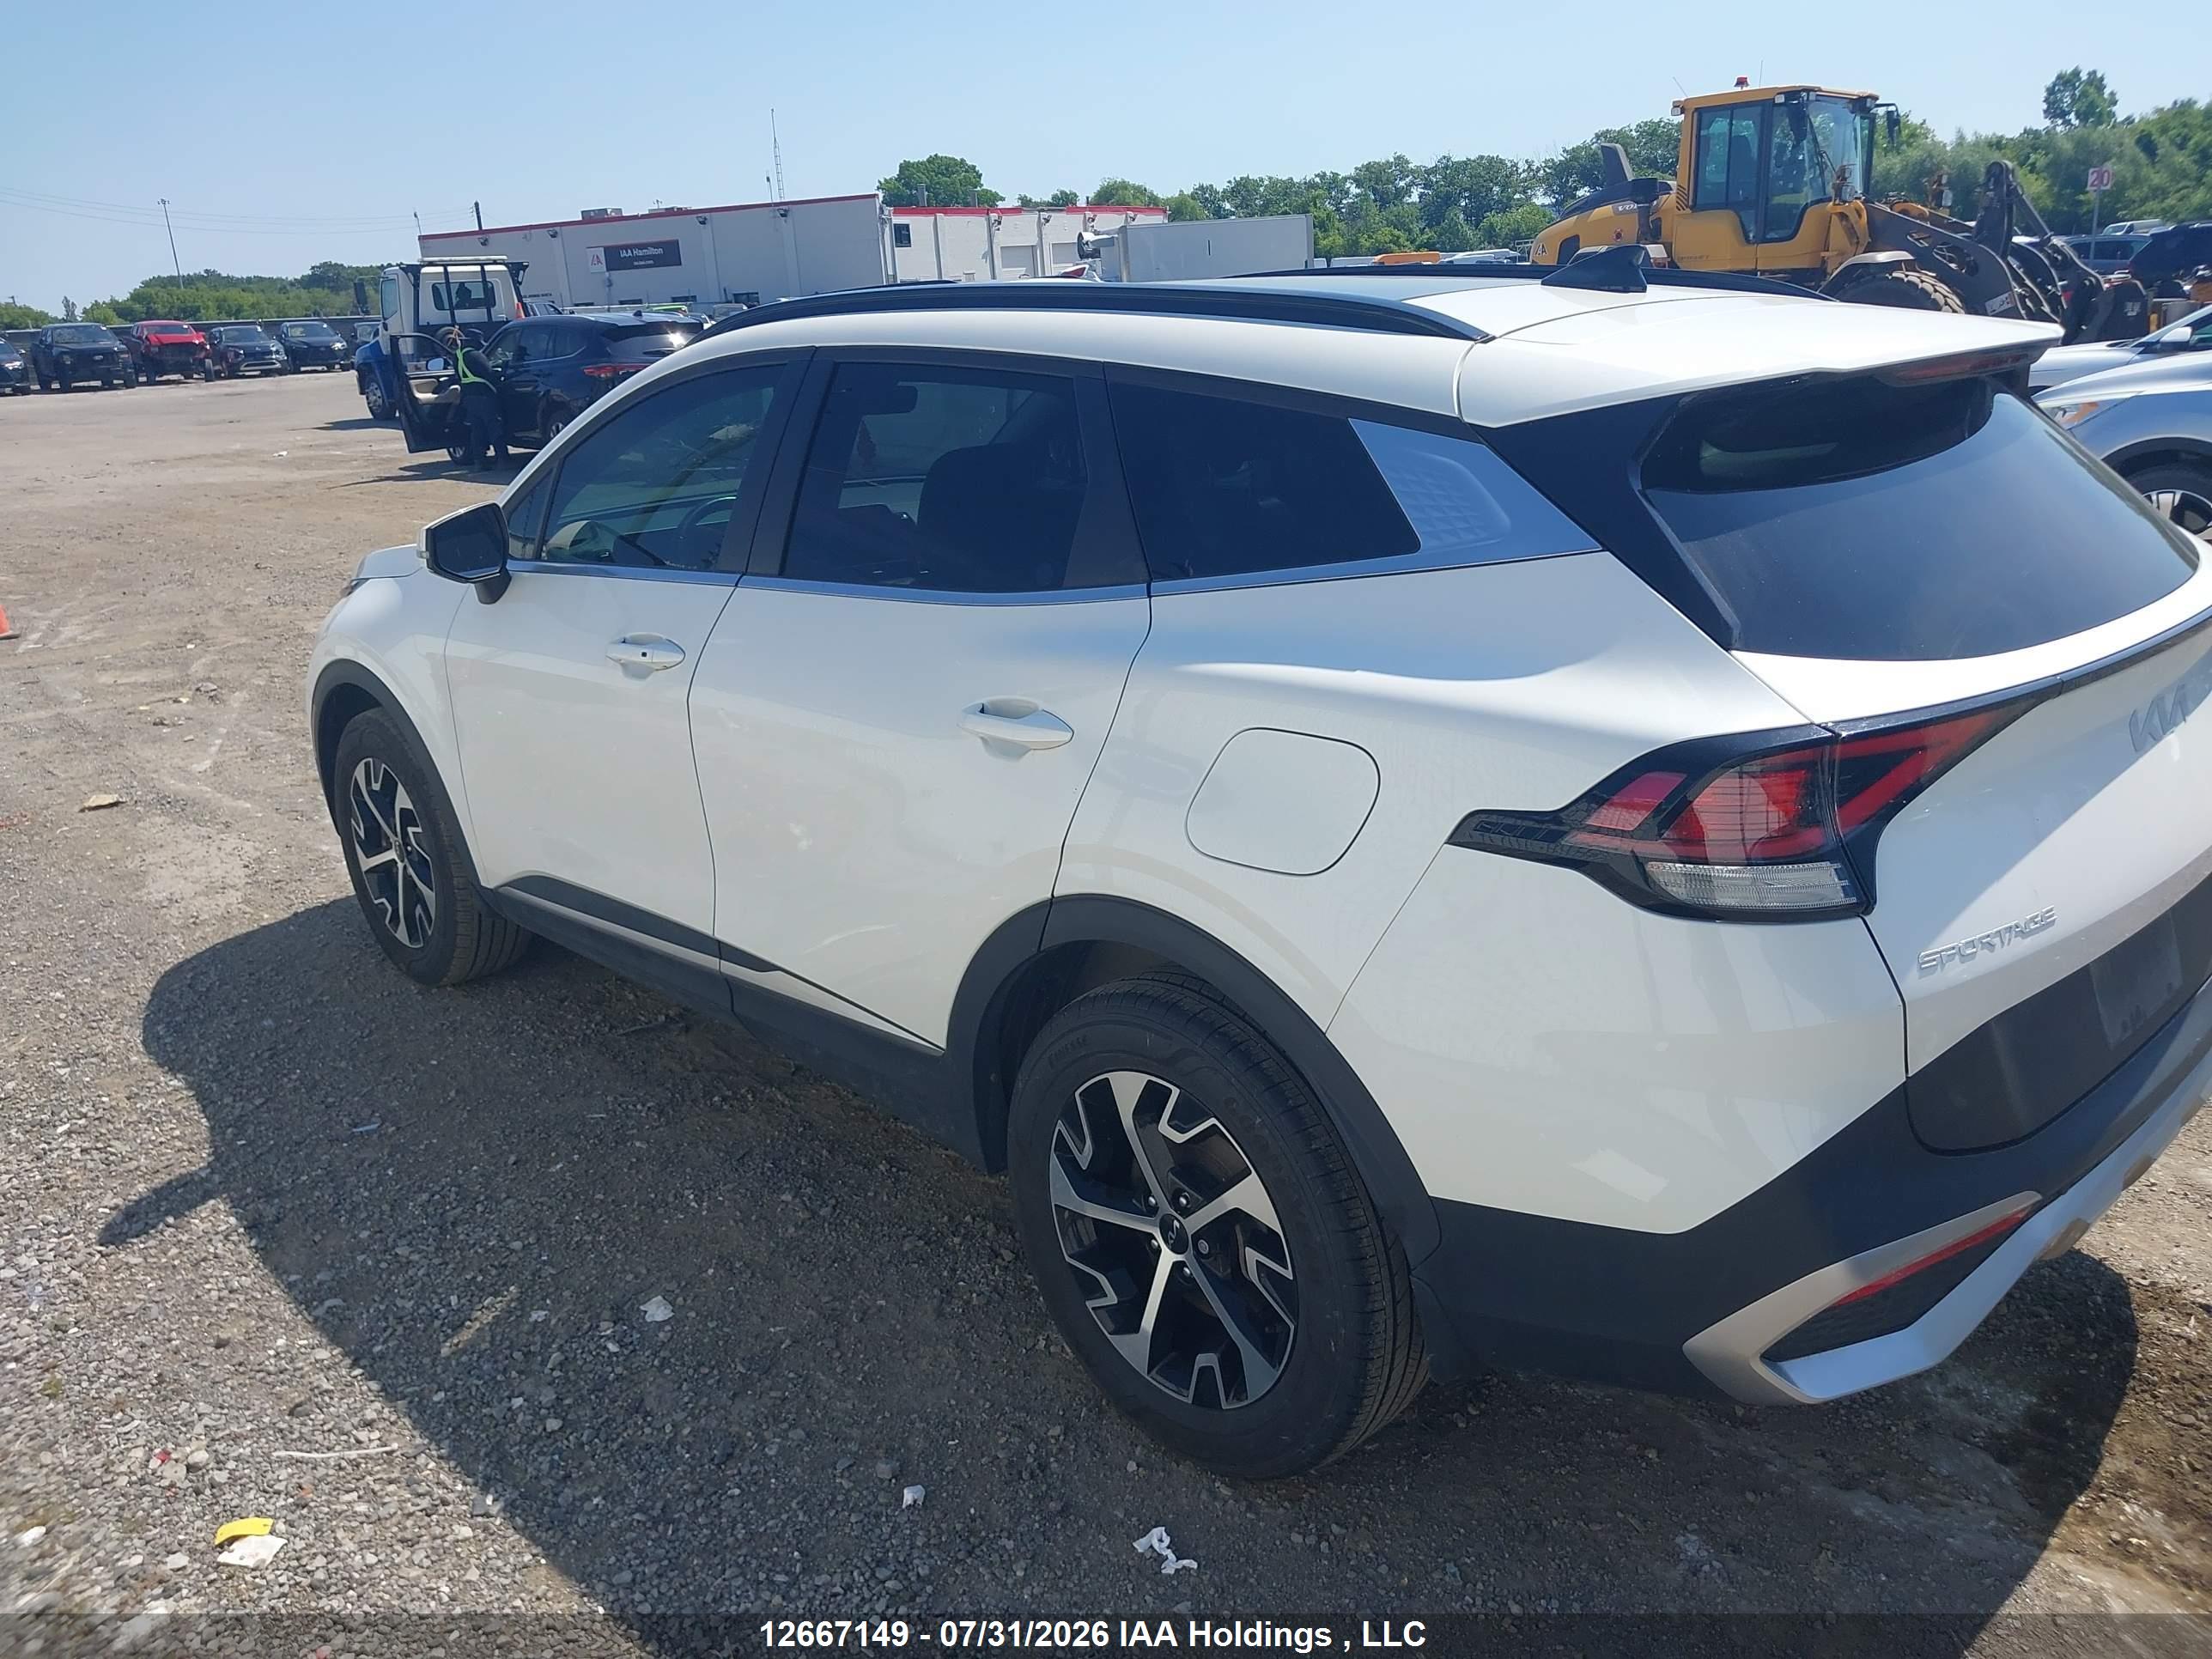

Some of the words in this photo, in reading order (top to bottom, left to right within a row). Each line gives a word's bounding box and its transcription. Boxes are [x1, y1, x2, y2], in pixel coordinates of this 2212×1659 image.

[2089, 170, 2110, 187] 20
[619, 248, 632, 258] IAA
[632, 246, 664, 257] Hamilton
[1917, 904, 2058, 969] SPORTAGE
